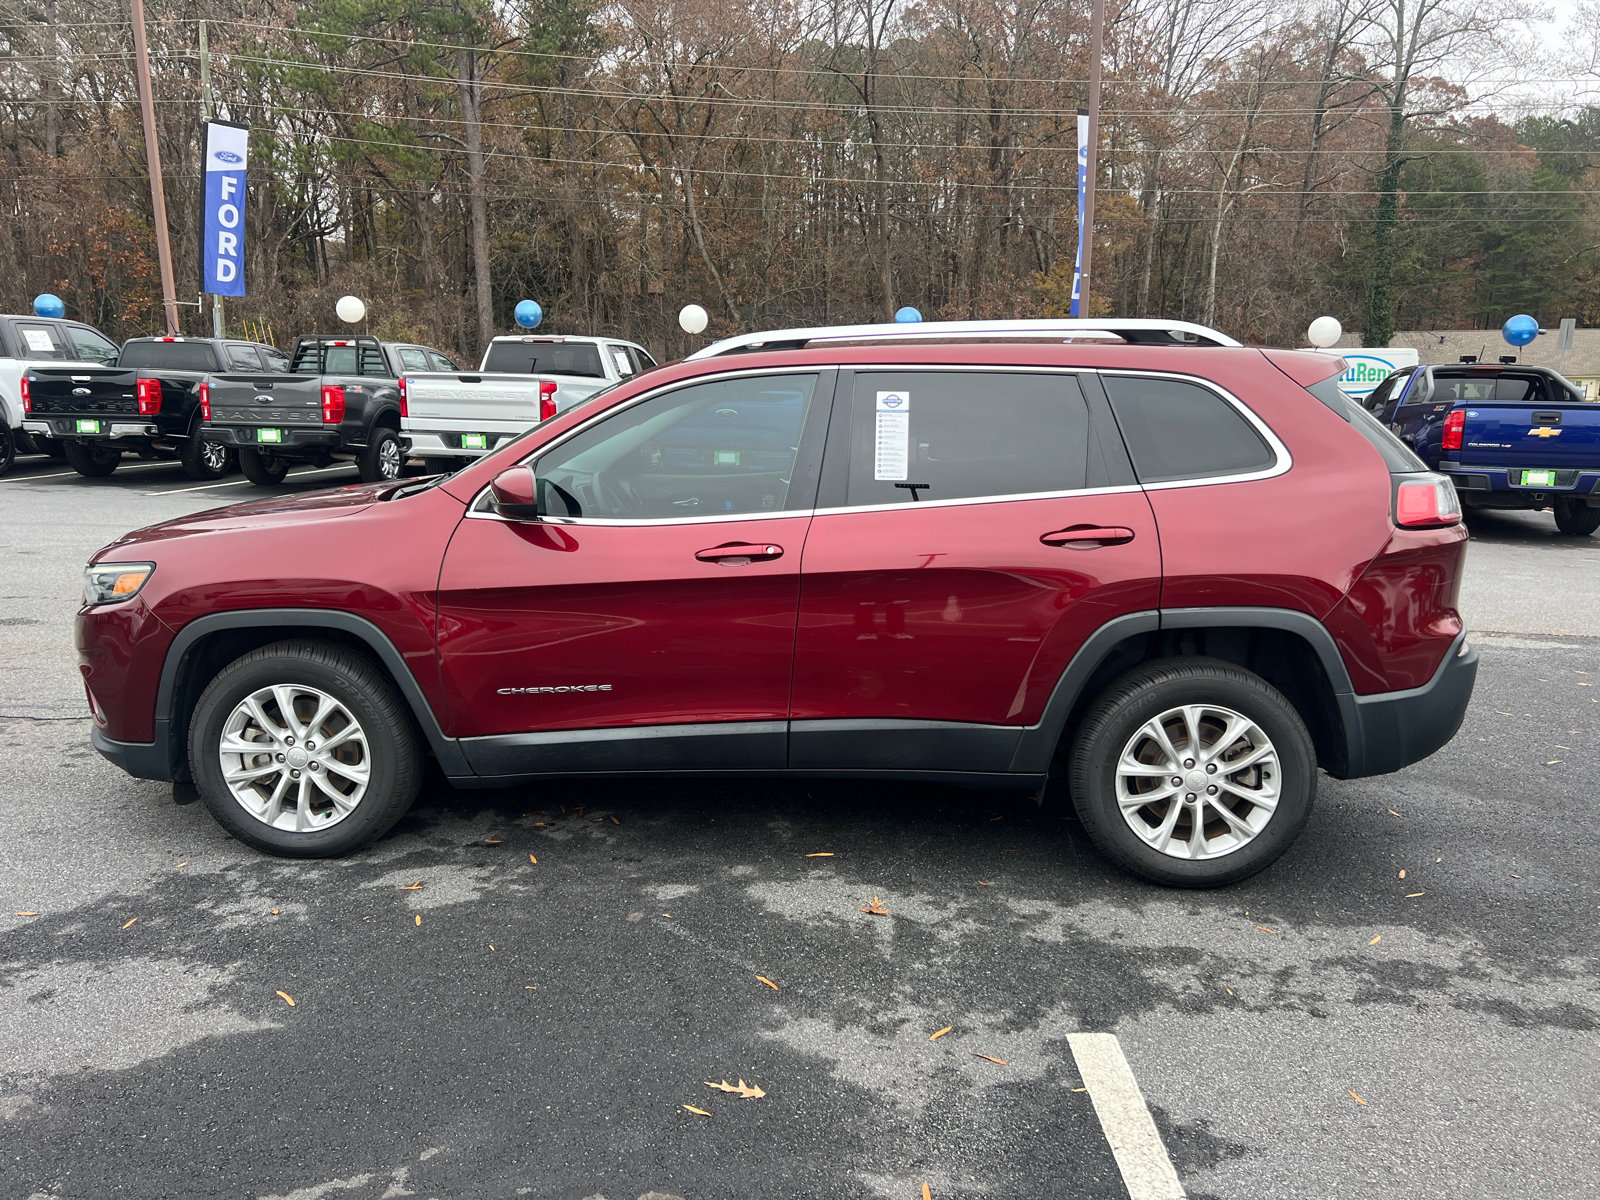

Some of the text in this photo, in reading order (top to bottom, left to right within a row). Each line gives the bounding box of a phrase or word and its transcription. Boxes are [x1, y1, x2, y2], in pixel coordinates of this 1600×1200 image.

[220, 152, 237, 162] Ford
[217, 175, 239, 283] FORD
[413, 389, 529, 400] CHEVROLET
[213, 410, 320, 421] RANGER
[496, 684, 613, 695] CHEROKEE
[333, 674, 385, 733] DEXTERO
[1098, 692, 1157, 749] DEXTERO
